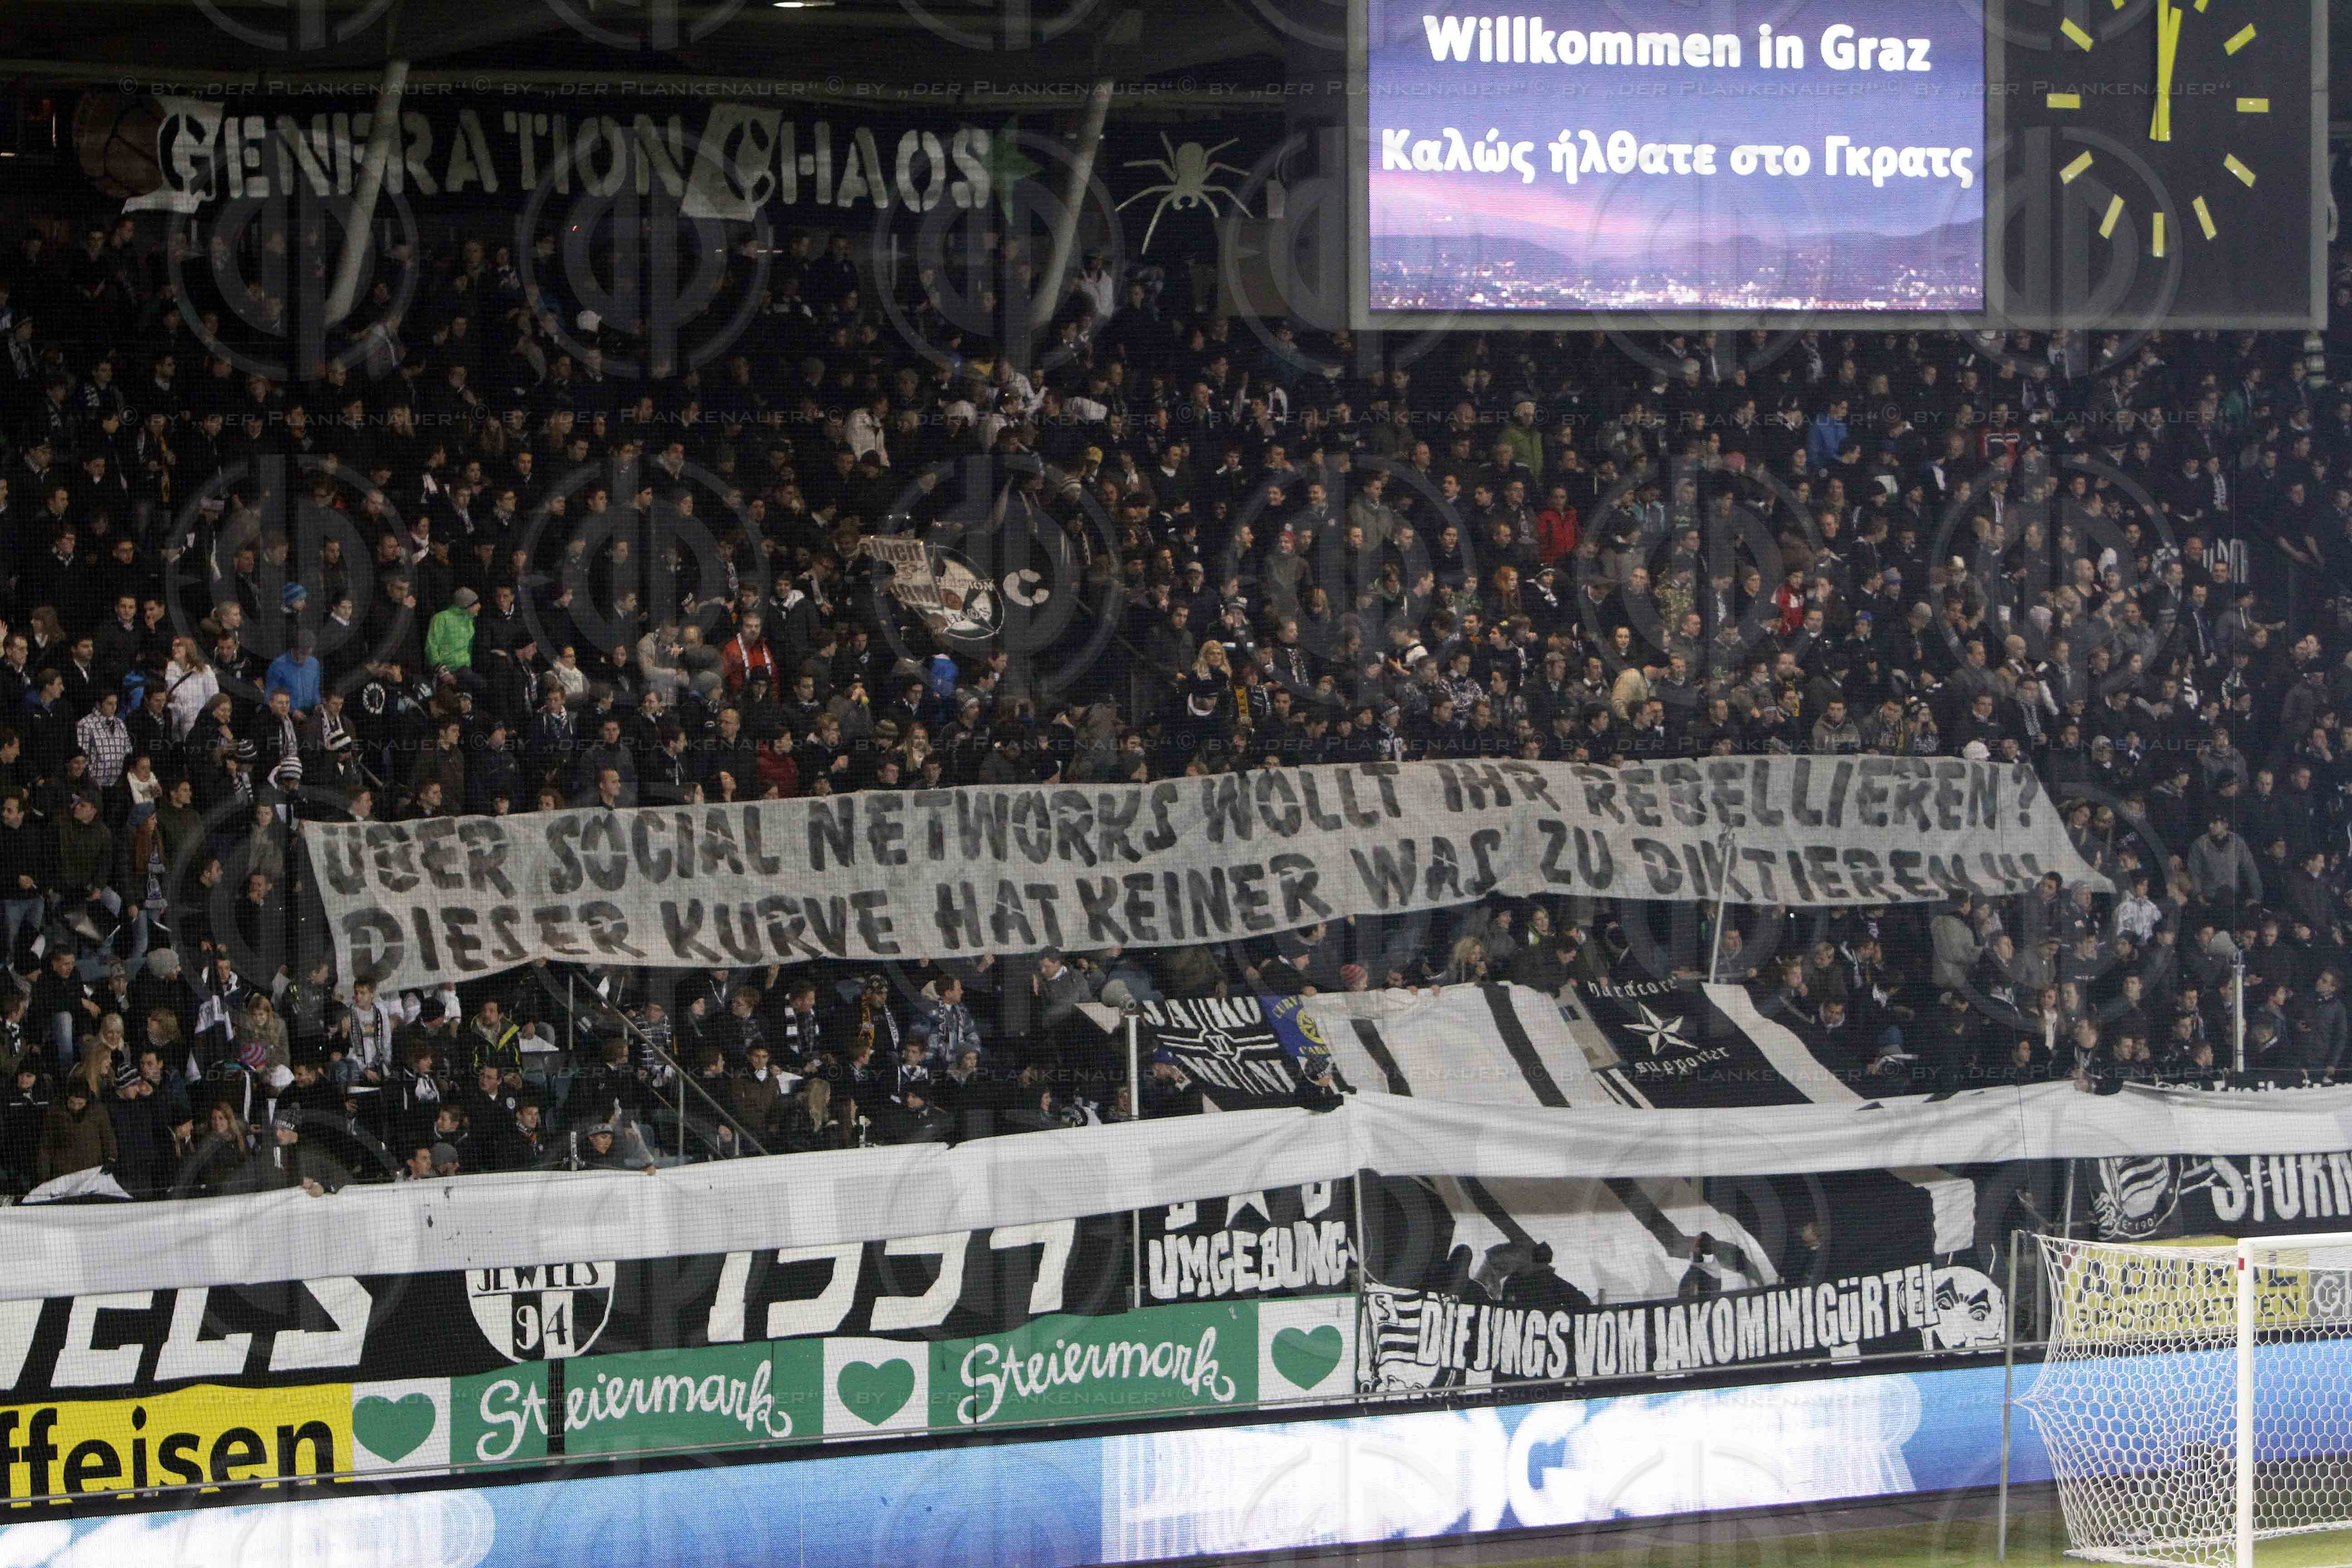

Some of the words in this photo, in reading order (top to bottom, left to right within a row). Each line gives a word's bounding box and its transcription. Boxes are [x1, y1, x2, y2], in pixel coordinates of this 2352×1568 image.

[1423, 15, 1740, 68] Willkommen
[1759, 23, 1804, 69] in
[1820, 23, 1931, 71] Graz
[1382, 127, 1535, 184] Καλώς
[1548, 128, 1717, 184] ήλθατε
[1730, 142, 1811, 176] στο
[1824, 135, 1973, 187] Γκρατς
[547, 803, 780, 894] SOCIAL
[808, 782, 1179, 871] NETWORKS
[1201, 762, 1401, 844] WOLLT
[1434, 761, 1561, 812] IHR
[342, 900, 646, 983] DIESER
[660, 889, 901, 965] KURVE
[935, 879, 1063, 949] HAT
[1075, 852, 1333, 946] KEINER
[1350, 828, 1501, 908] WAS
[1538, 818, 1613, 890] ZU
[1148, 1220, 1348, 1299] UMGEBUNG
[515, 1300, 568, 1350] 94
[1416, 1300, 1475, 1369] DIE
[1574, 1307, 1647, 1377] VOM
[476, 1359, 793, 1461] Steiermark
[956, 1326, 1236, 1425] Steiermark
